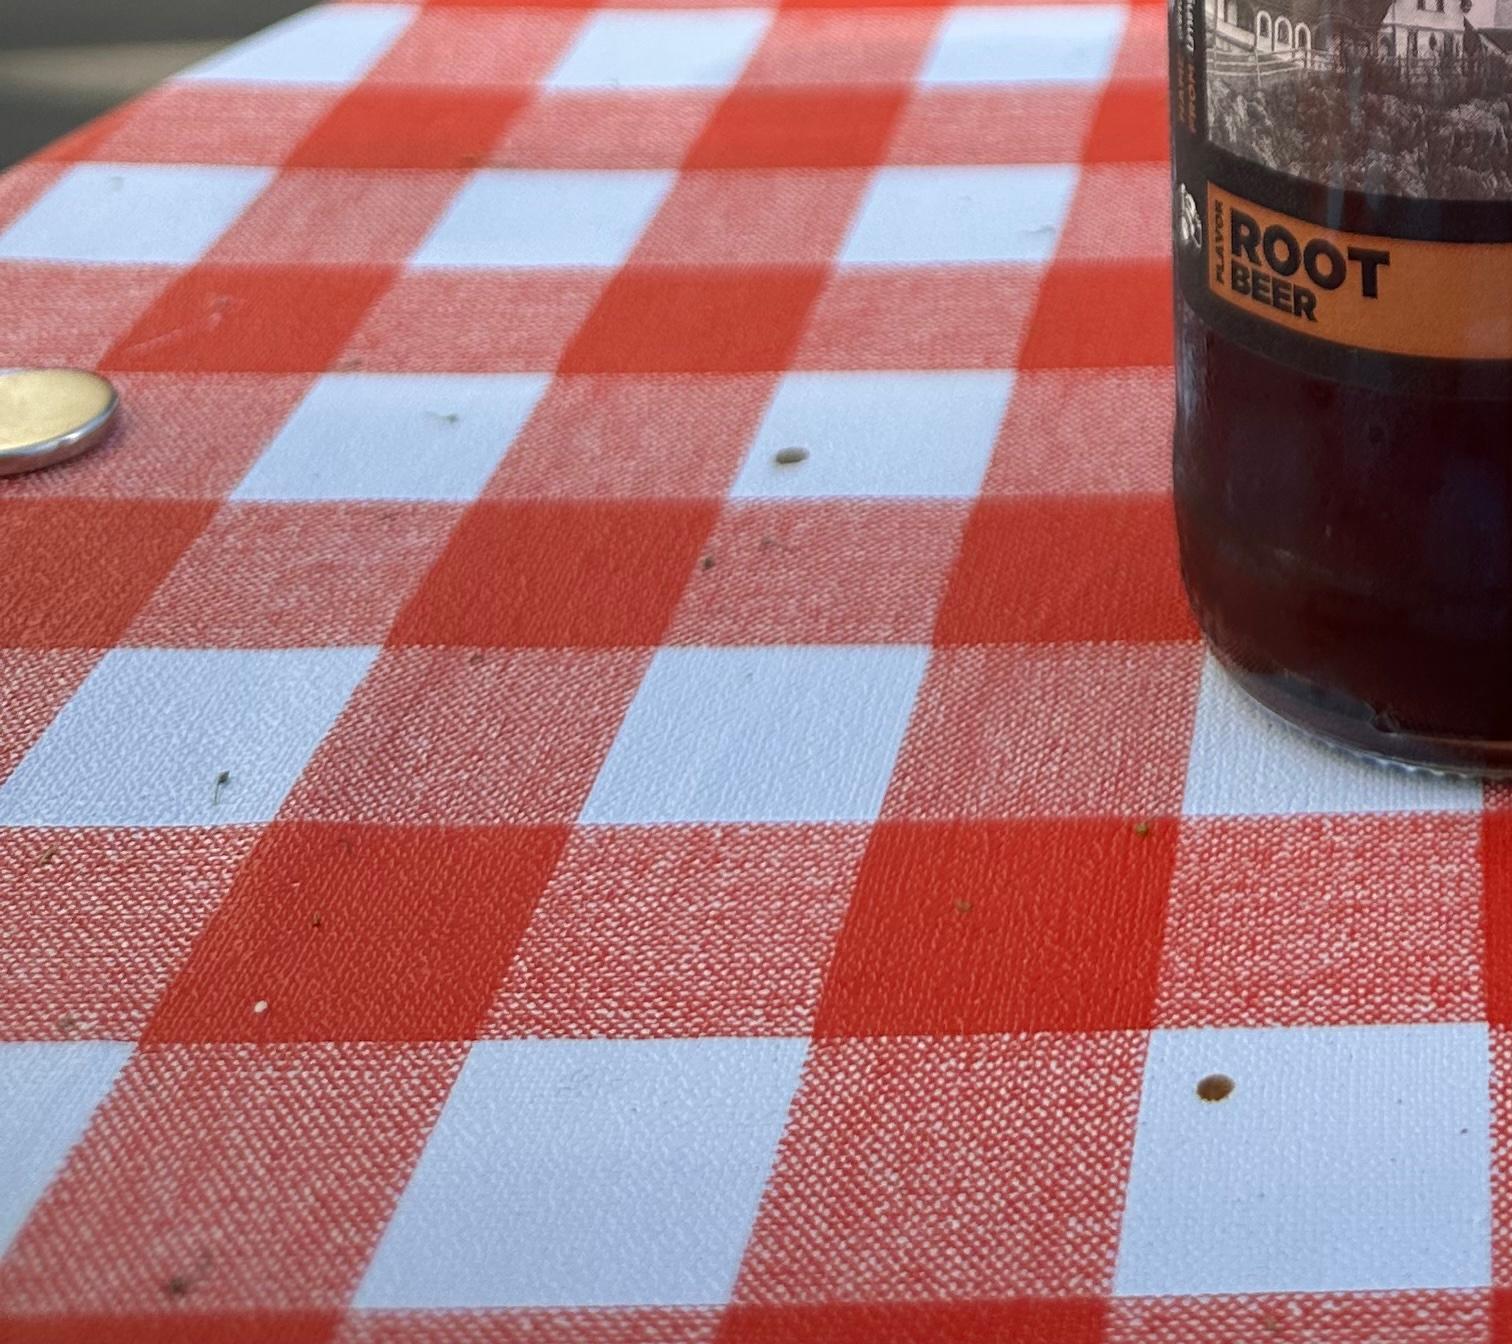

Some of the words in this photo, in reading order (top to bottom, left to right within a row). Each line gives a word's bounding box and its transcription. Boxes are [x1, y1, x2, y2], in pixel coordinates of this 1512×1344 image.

[1213, 199, 1224, 286] FLAVOR
[1229, 206, 1391, 301] ROOT
[1230, 260, 1318, 323] BEER
